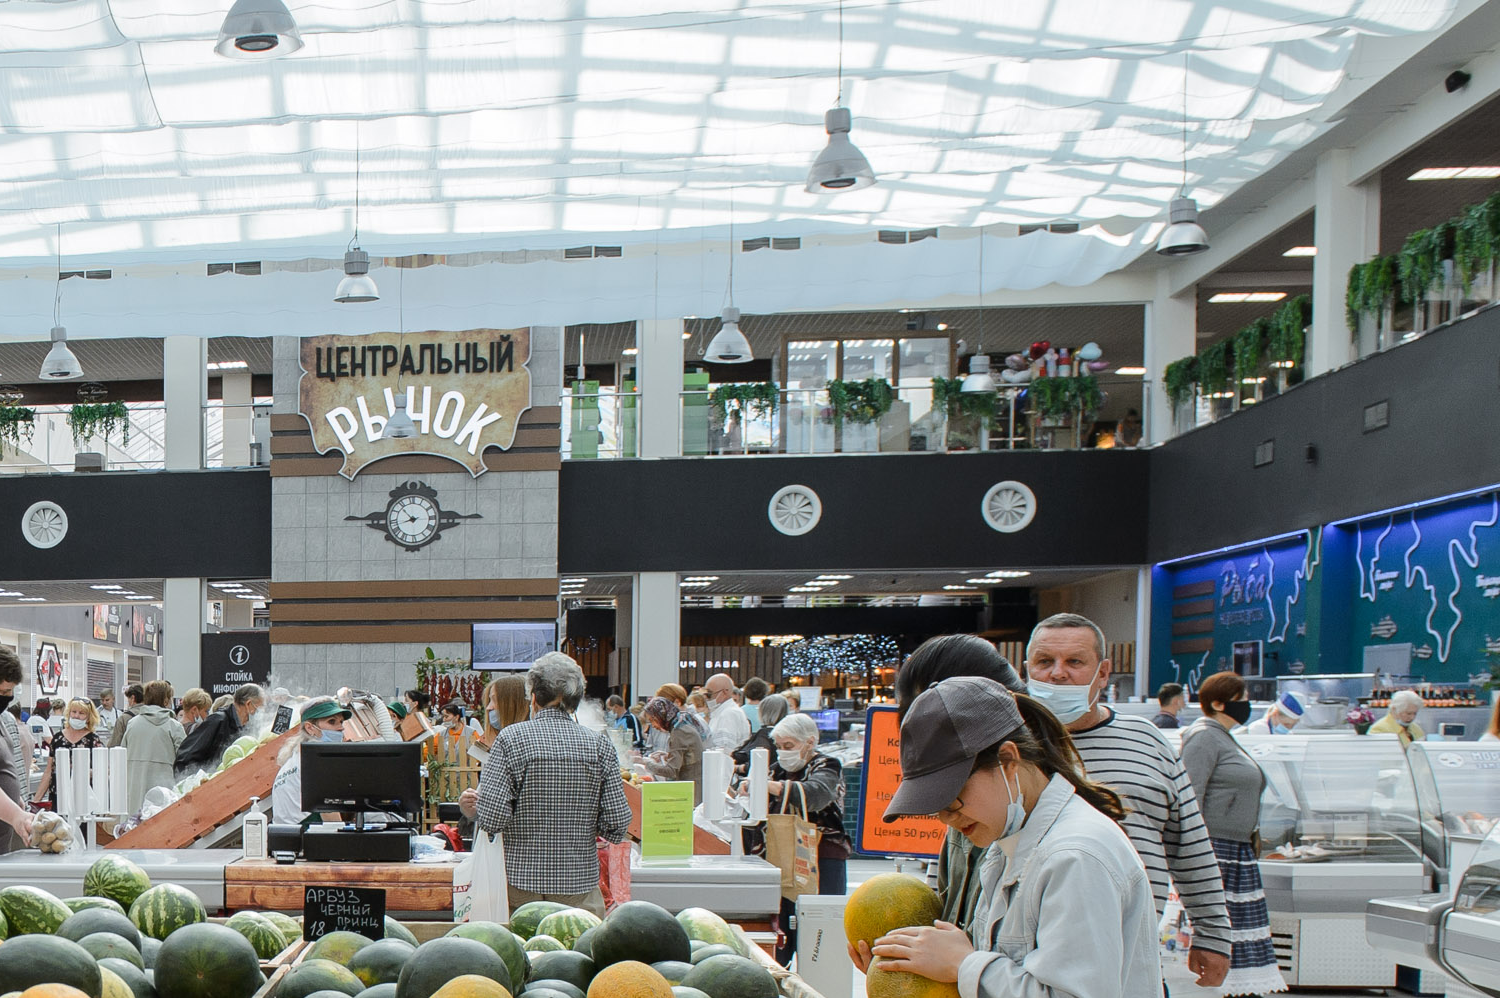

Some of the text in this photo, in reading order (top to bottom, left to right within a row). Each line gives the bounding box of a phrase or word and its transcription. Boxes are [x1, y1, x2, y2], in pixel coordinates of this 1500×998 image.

[315, 334, 514, 382] ЦЕНТРАЛЬНЫЙ
[325, 385, 503, 456] РЫНОК
[705, 660, 740, 669] BABA
[225, 670, 253, 682] СТОЙКА
[878, 755, 900, 766] Цен
[874, 827, 901, 838] Цена
[904, 828, 917, 838] 50
[306, 888, 361, 903] АРБУЗ
[320, 904, 371, 916] ЧЕРНЫЙ
[309, 920, 326, 936] 18
[337, 916, 379, 928] ПРИНЦ
